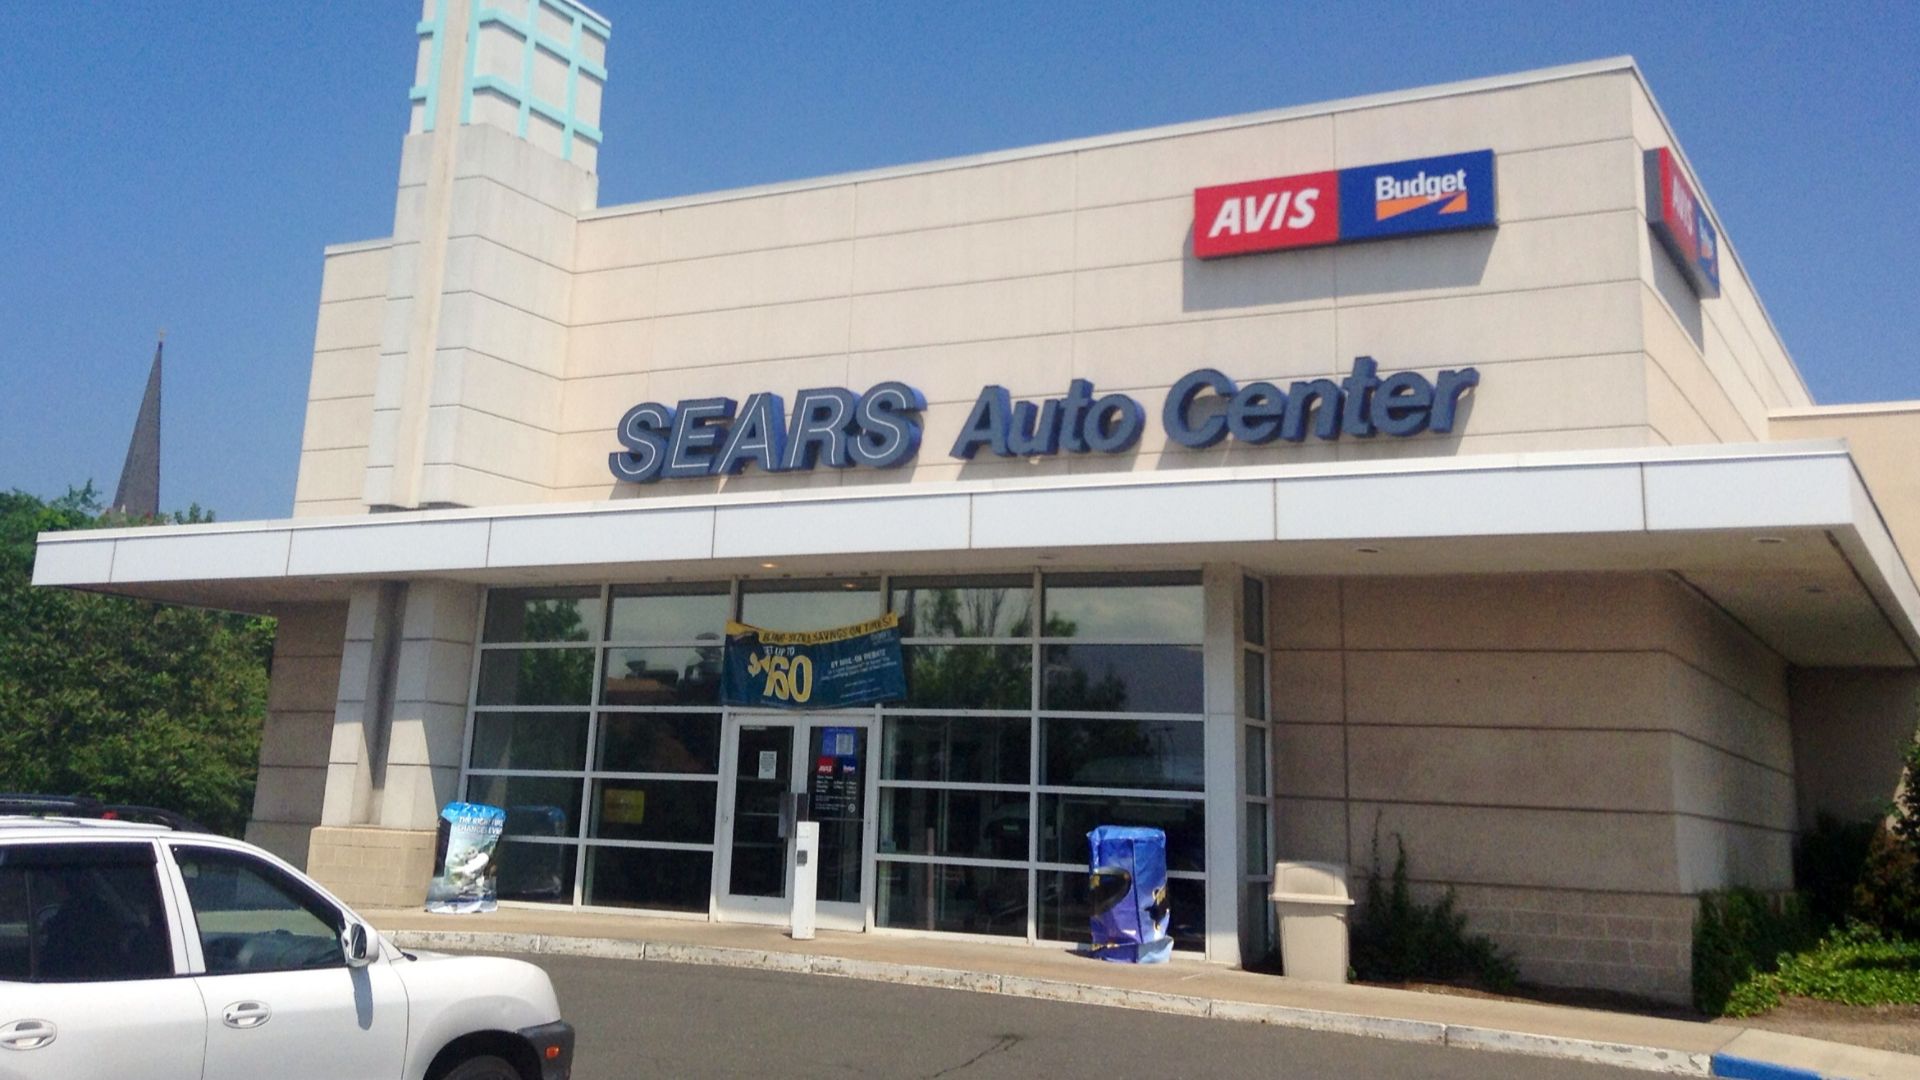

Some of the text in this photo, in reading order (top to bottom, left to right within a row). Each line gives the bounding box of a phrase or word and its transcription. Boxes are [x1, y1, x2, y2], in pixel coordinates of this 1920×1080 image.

[1375, 169, 1467, 201] Budget
[1207, 188, 1320, 238] AVIS
[608, 356, 1480, 483] SEARS Auto Center
